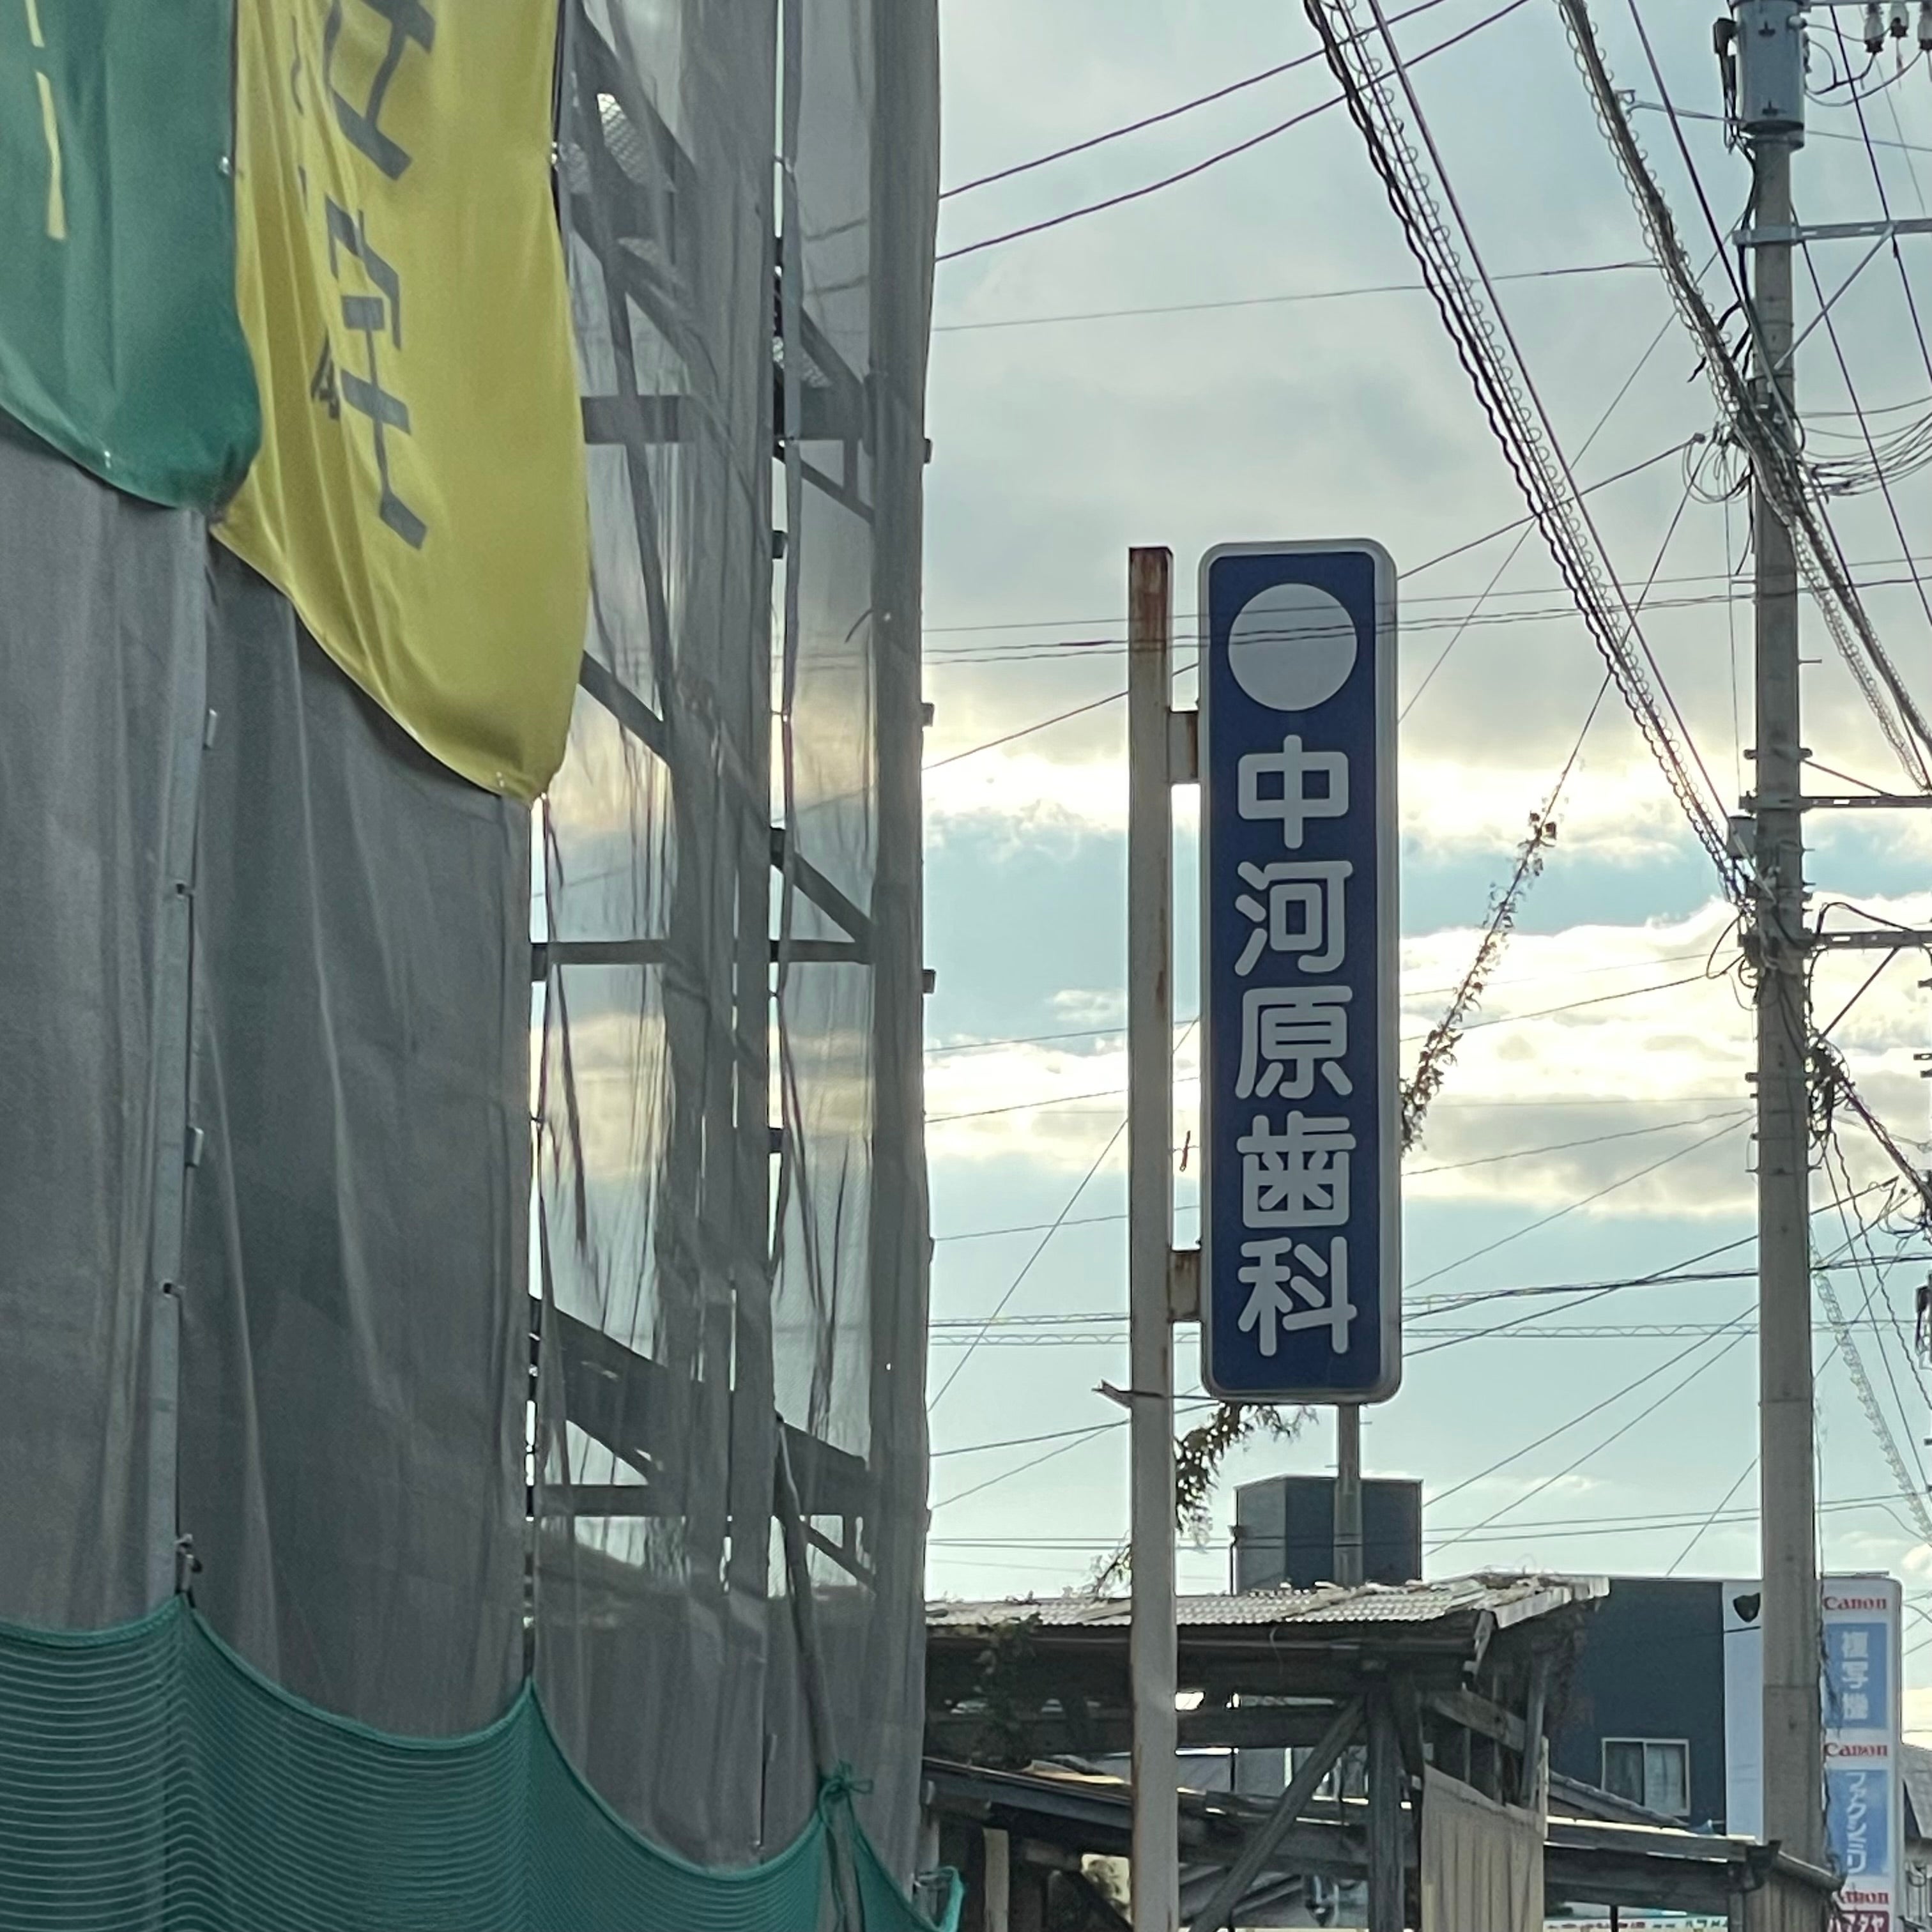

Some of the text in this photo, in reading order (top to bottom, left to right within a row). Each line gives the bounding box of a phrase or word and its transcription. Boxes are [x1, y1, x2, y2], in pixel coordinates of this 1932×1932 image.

[1235, 734, 1357, 1356] 中河原歯科
[1824, 1597, 1887, 1610] Canon
[1824, 1743, 1888, 1756] Canon
